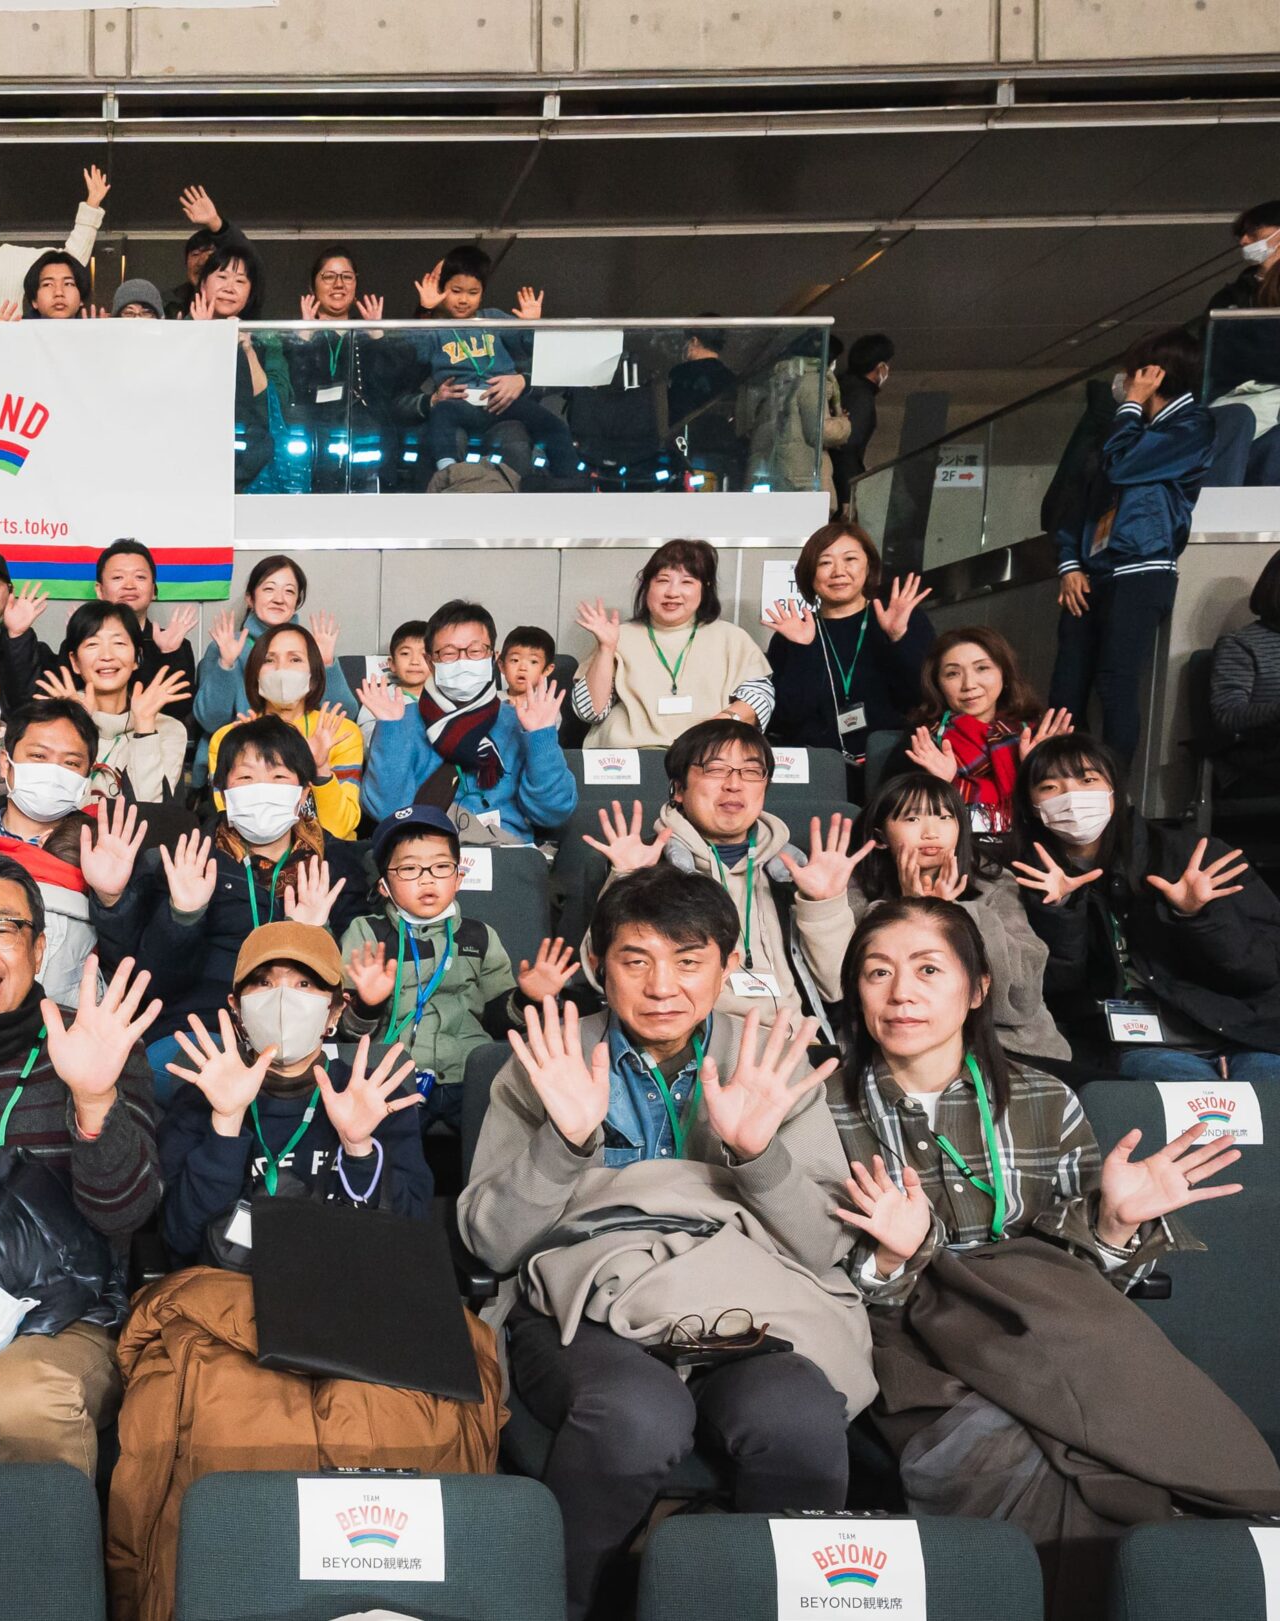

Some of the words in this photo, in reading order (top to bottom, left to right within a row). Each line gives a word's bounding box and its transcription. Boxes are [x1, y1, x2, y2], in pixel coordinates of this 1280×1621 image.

[942, 470, 957, 481] 2F
[1187, 1096, 1236, 1113] BEYOND
[335, 1505, 409, 1531] BEYOND
[838, 1532, 856, 1540] TEAM
[322, 1557, 422, 1570] BEYOND観戦席
[812, 1543, 888, 1570] BEYOND
[800, 1596, 903, 1610] BEYOND観戦席
